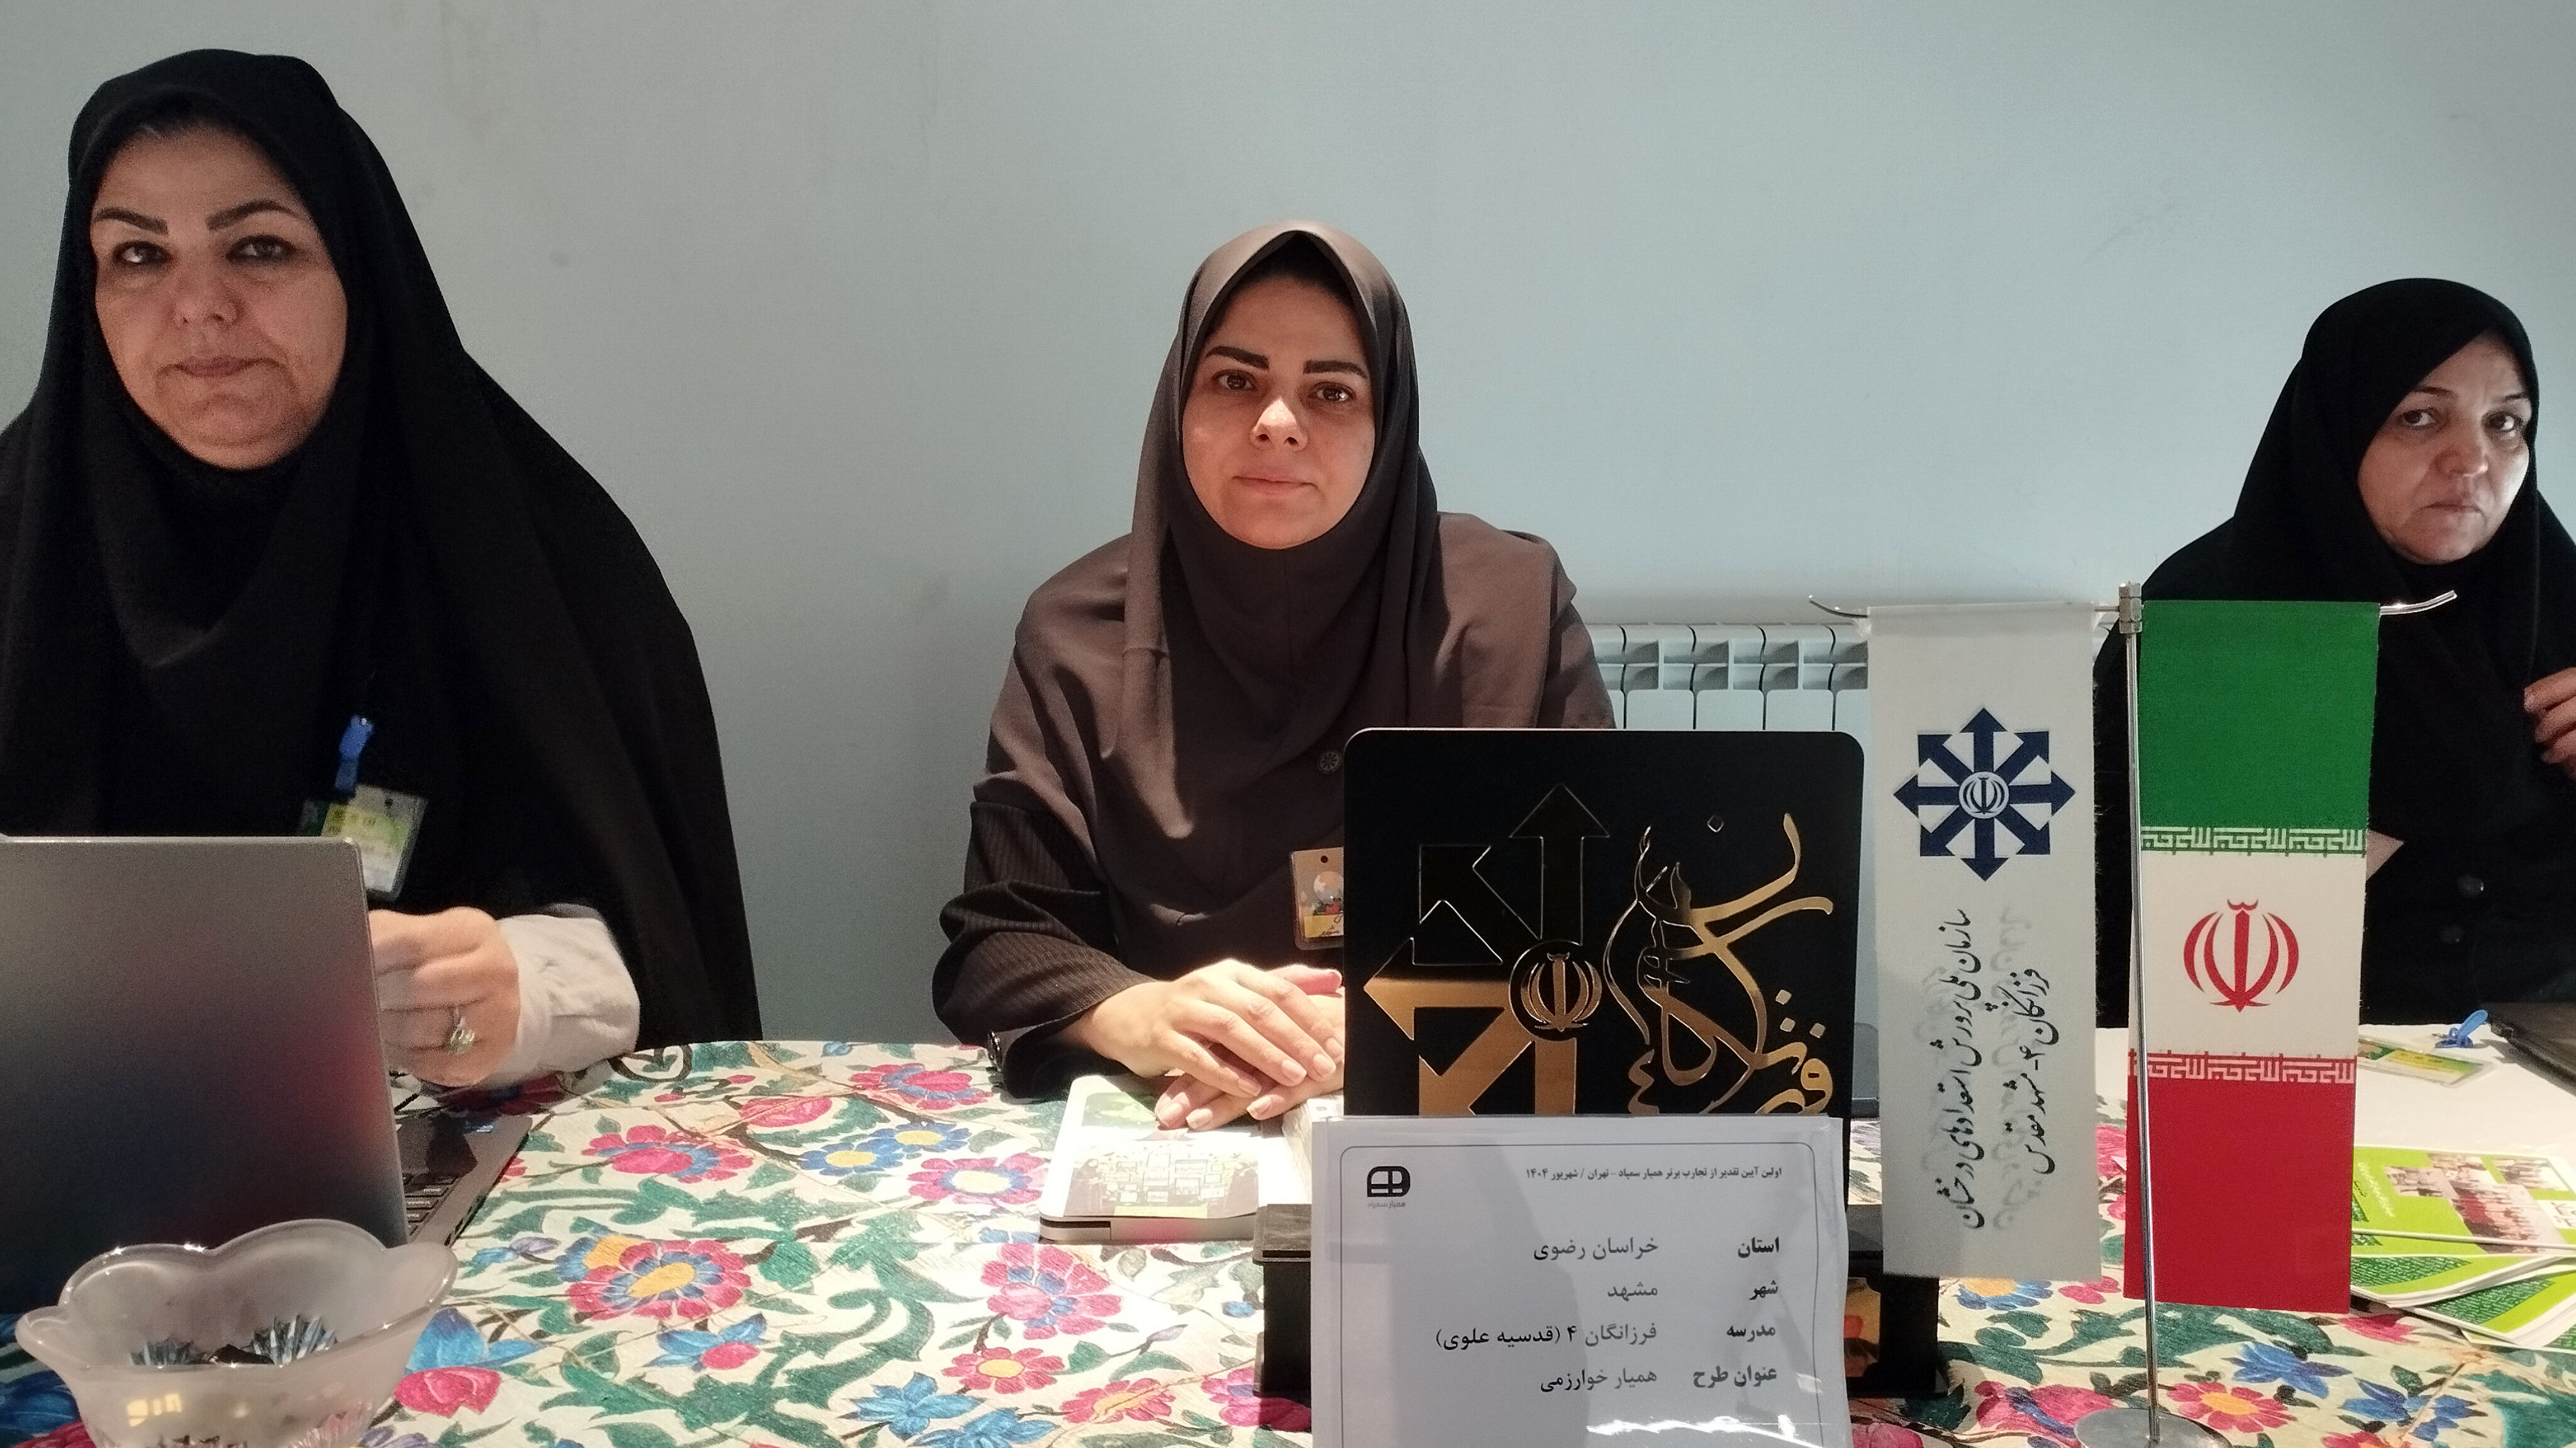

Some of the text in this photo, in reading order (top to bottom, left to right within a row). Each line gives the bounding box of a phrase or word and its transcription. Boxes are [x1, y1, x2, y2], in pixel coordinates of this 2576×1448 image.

[1938, 909, 1981, 973] سازمان
[1938, 976, 1981, 1000] ملی
[1997, 969, 2059, 1045] فرزانگان
[2002, 1072, 2046, 1115] مشهد
[2004, 1115, 2055, 1174] مقدس
[1551, 1171, 1578, 1181] شهریور
[1587, 1168, 1609, 1180] تهران
[1643, 1168, 1663, 1180] همیار
[1665, 1167, 1680, 1179] برتر
[1682, 1167, 1707, 1179] تجارب
[1709, 1167, 1717, 1179] از
[1719, 1167, 1739, 1179] تقدیر
[1741, 1166, 1758, 1179] آیین
[1762, 1167, 1782, 1179] اولین
[1935, 1162, 1985, 1229] درخشان
[1533, 1237, 1779, 1260] استان خراسان رضوی
[1607, 1280, 1779, 1301] شهر مشهد
[1585, 1322, 1657, 1347] فرزانگان
[1726, 1324, 1775, 1342] مدرسه
[1540, 1364, 1777, 1393] عنوان طرح همیار خوارزمی
